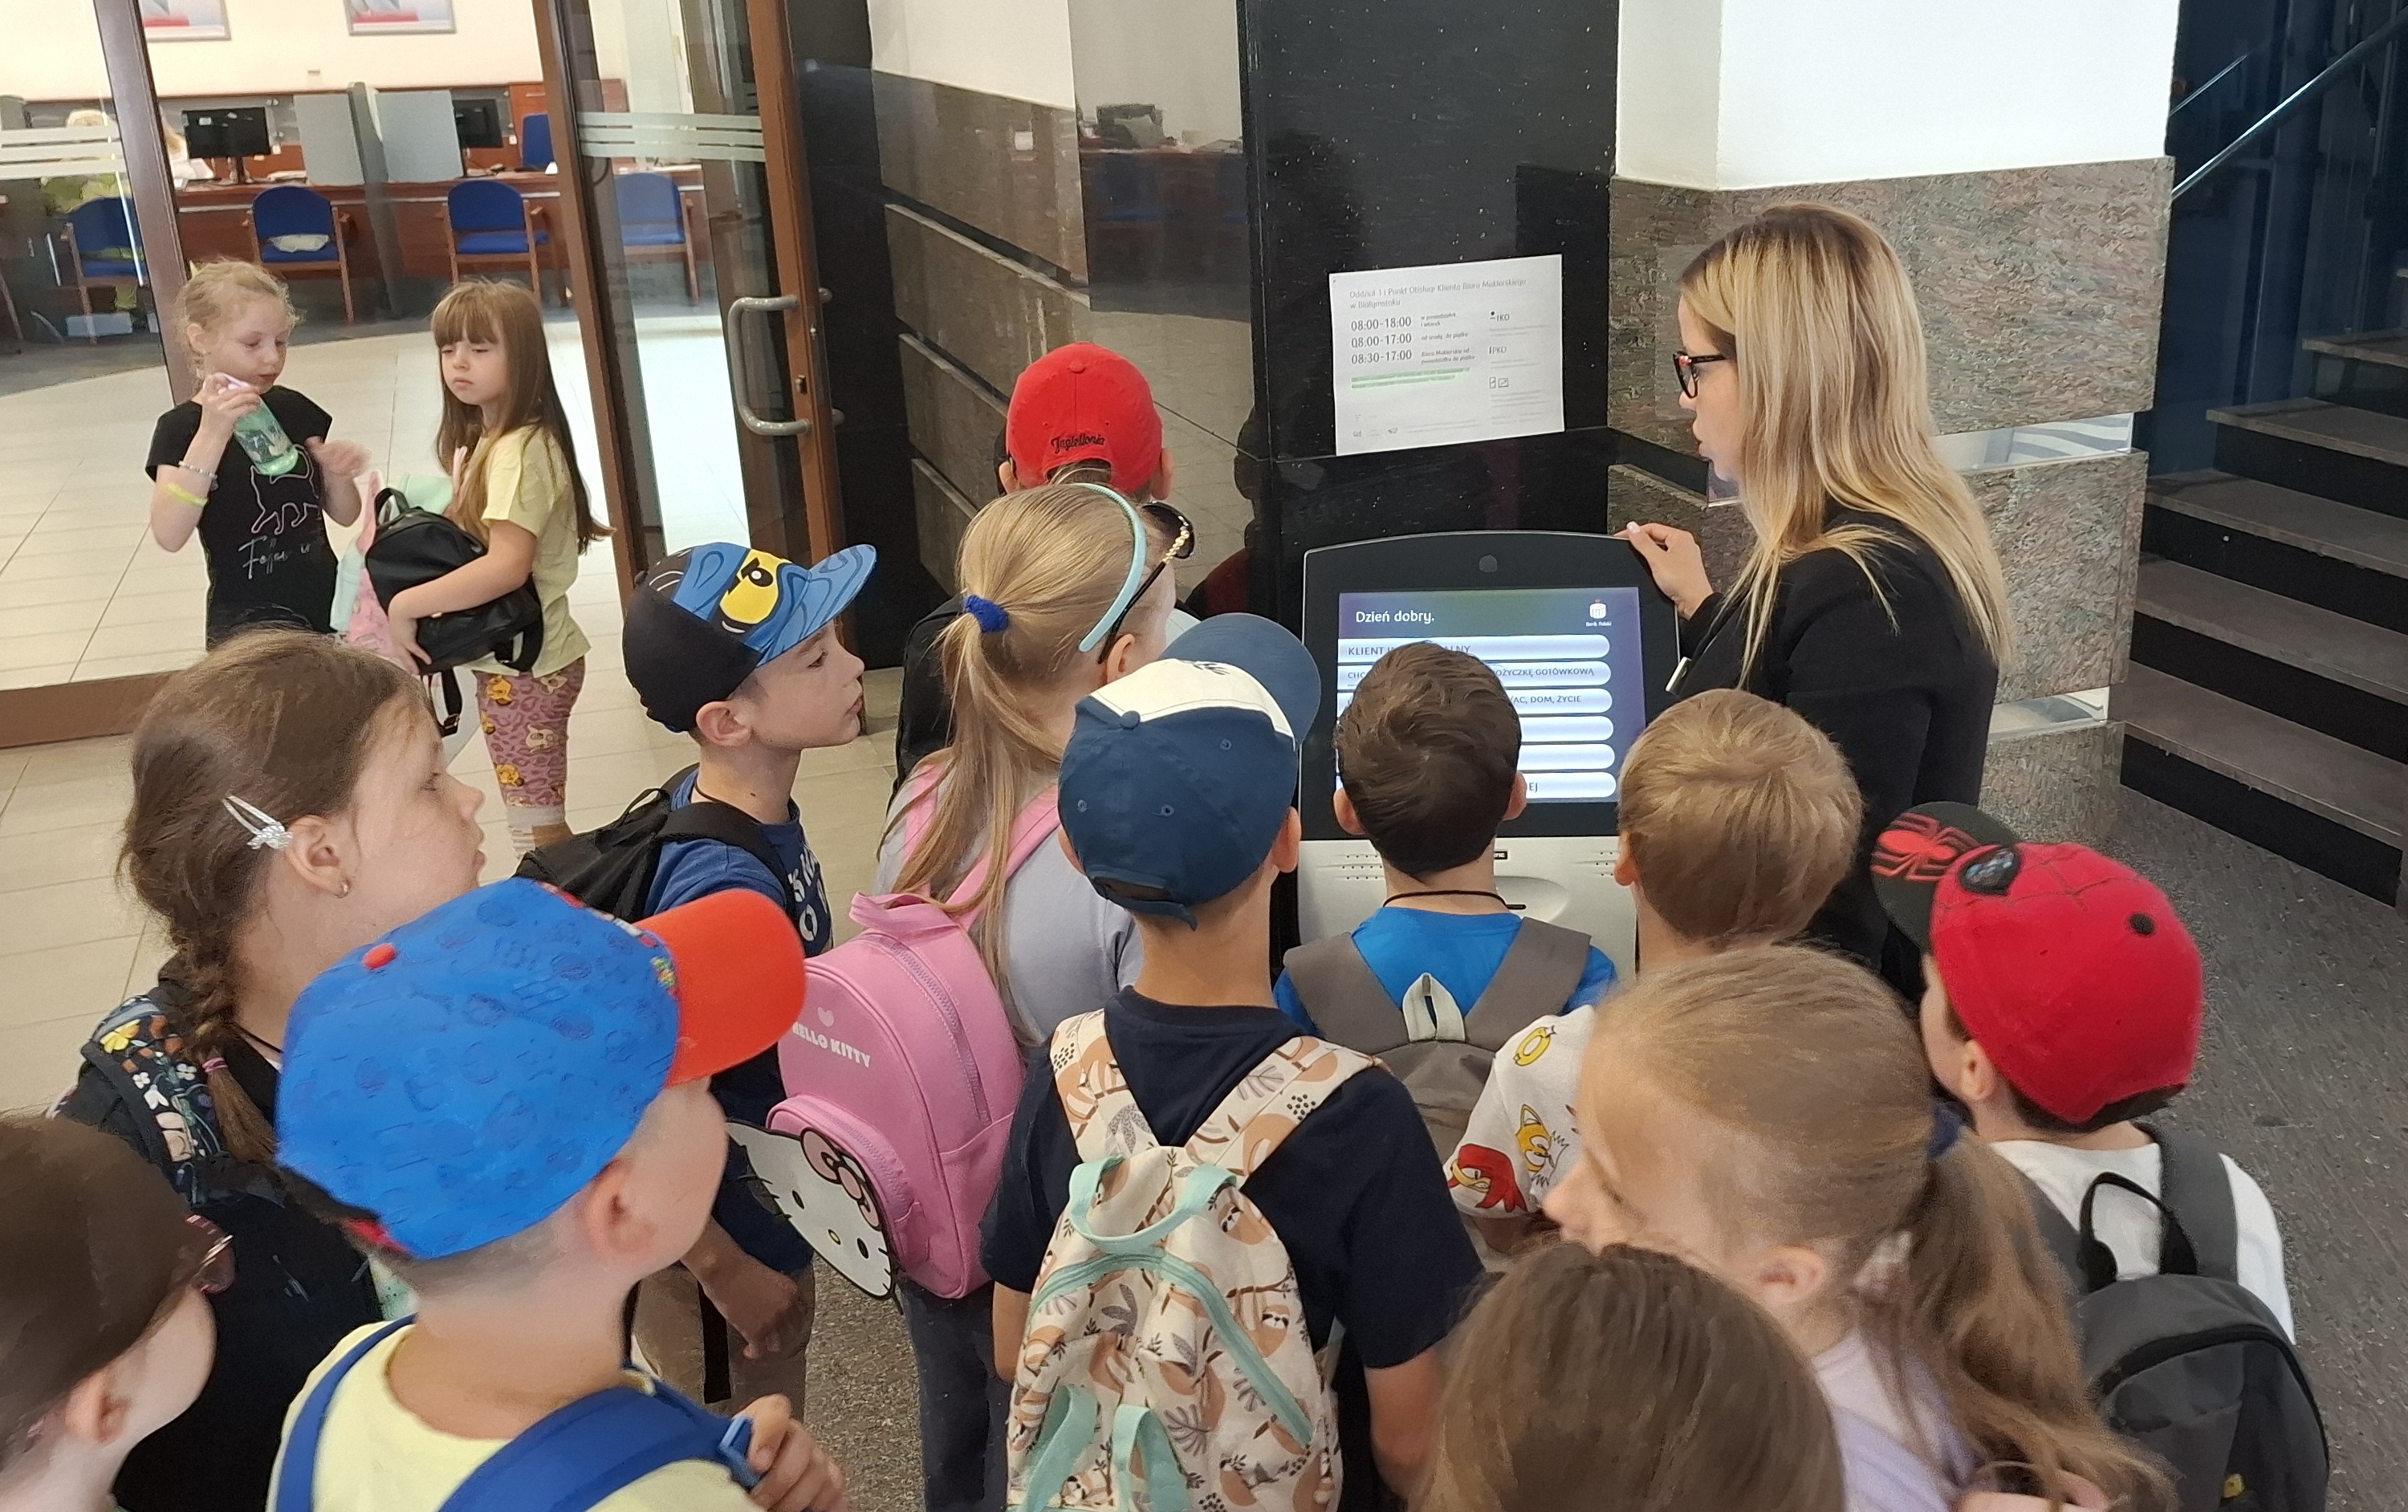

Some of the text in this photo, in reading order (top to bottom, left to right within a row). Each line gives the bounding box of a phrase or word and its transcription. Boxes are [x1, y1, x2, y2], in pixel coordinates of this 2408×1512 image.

[1388, 287, 1407, 296] Punkt
[1351, 316, 1412, 331] 08:00-18:00
[1351, 333, 1412, 348] 08:00-17:00
[1351, 349, 1412, 364] 08:30-17:00
[1356, 609, 1435, 624] Dzień dobry.
[1348, 646, 1385, 656] KLIENT
[1495, 667, 1594, 677] OŻYCZKĘ GOTÓWKOWĄ
[1530, 695, 1555, 704] DOM,
[1557, 694, 1582, 703] ŻYCIE
[830, 1038, 871, 1068] KITTY
